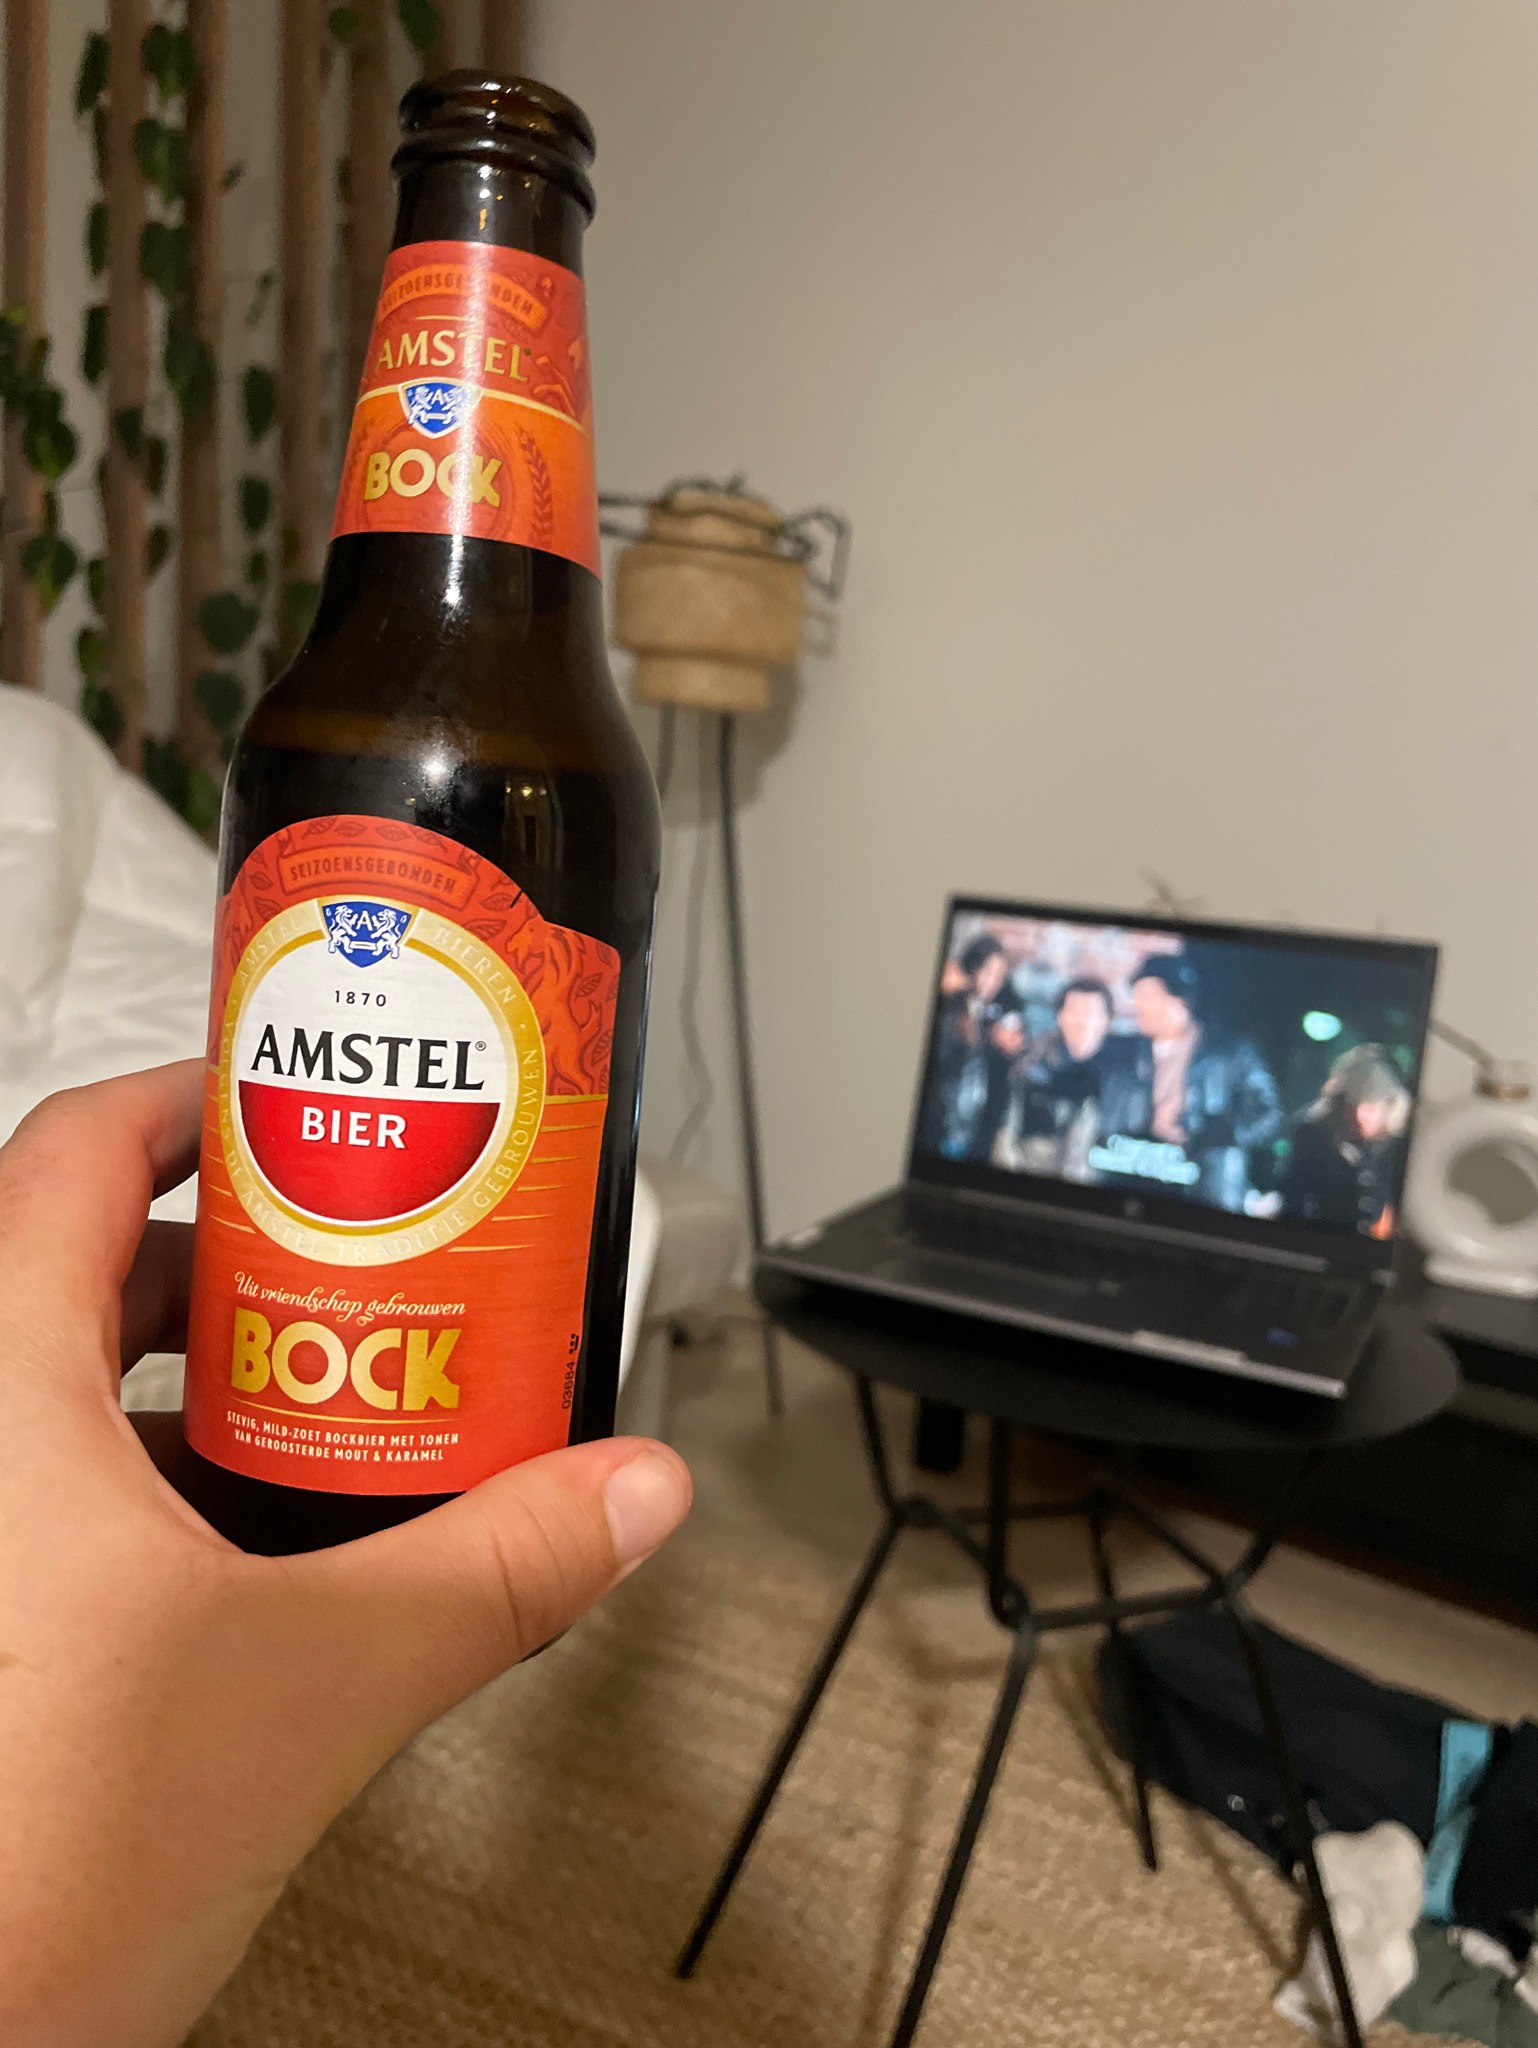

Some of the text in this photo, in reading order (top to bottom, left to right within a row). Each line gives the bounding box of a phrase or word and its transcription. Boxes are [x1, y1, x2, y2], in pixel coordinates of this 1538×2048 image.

[374, 330, 529, 383] AMSTEL
[364, 448, 502, 508] BOCK
[290, 856, 457, 893] SEIZOENSGEBONDEN
[356, 910, 373, 931] A
[434, 927, 517, 1004] BIEREN
[335, 990, 387, 1007] 1870
[250, 1023, 485, 1091] AMSTEL
[302, 1107, 407, 1149] BIER
[473, 1049, 540, 1208] GEBROUWEN
[235, 1271, 466, 1326] Uit vriendschap gebrouwen
[230, 1306, 462, 1411] BOCK
[562, 1361, 575, 1410] 03684
[227, 1410, 459, 1446] STEVIG, MILD-ZOET BOCKBIER MET TONEN
[235, 1428, 444, 1461] VAN GEROOSTERDE MOUT & KARAMEL
